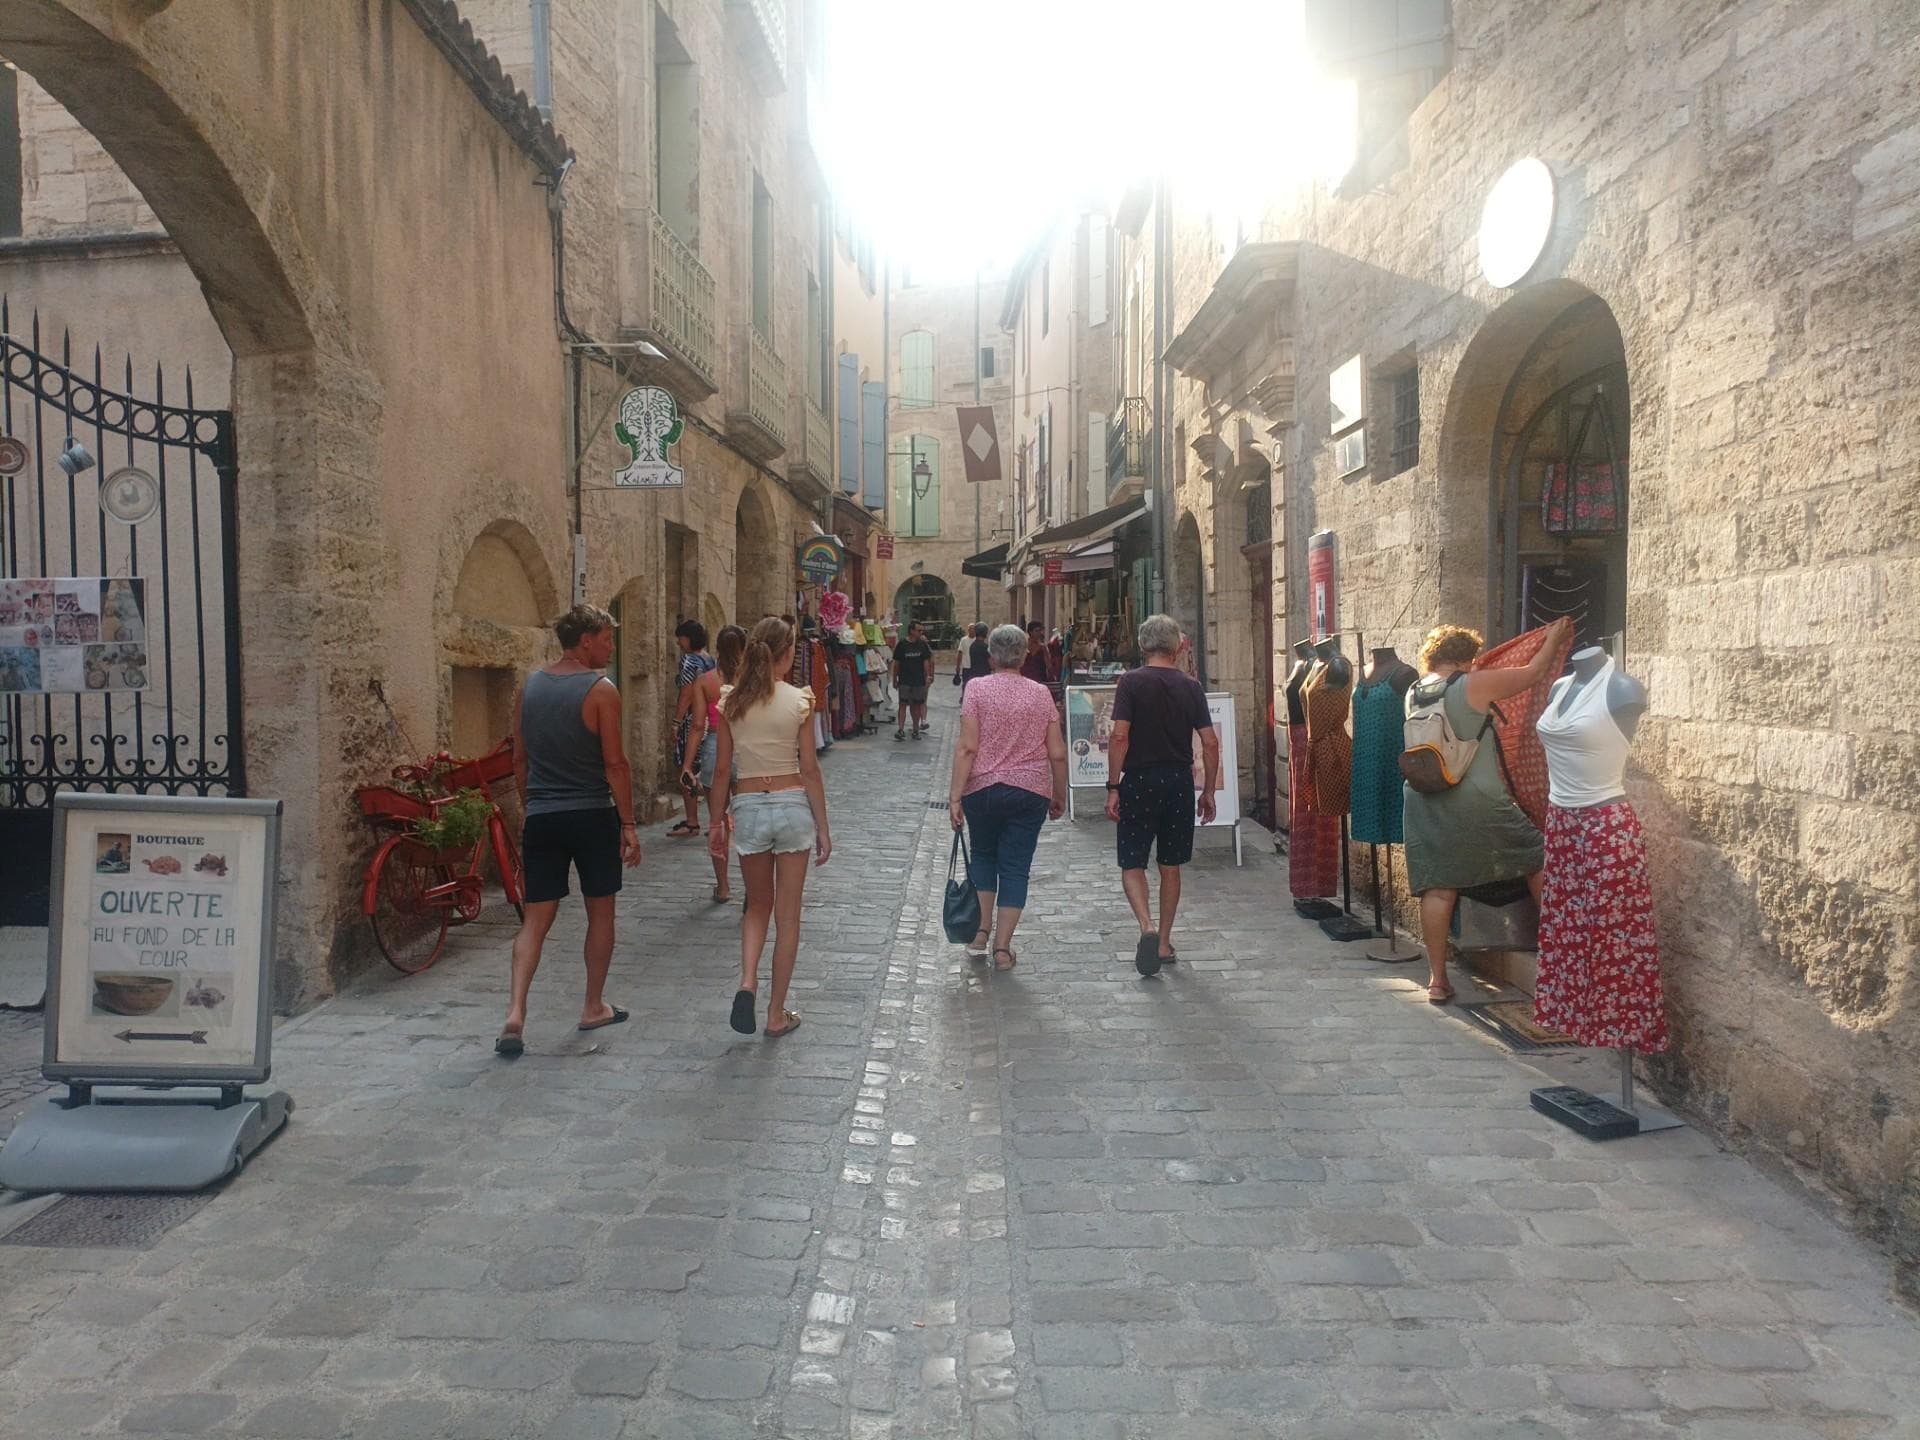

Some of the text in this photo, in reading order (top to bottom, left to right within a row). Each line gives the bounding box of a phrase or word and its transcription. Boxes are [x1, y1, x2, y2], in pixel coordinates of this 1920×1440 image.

[136, 835, 205, 846] BOUTIQUE
[100, 890, 223, 918] OUVERTE
[94, 926, 235, 946] AU FOND DE LA
[139, 950, 188, 968] COUR
